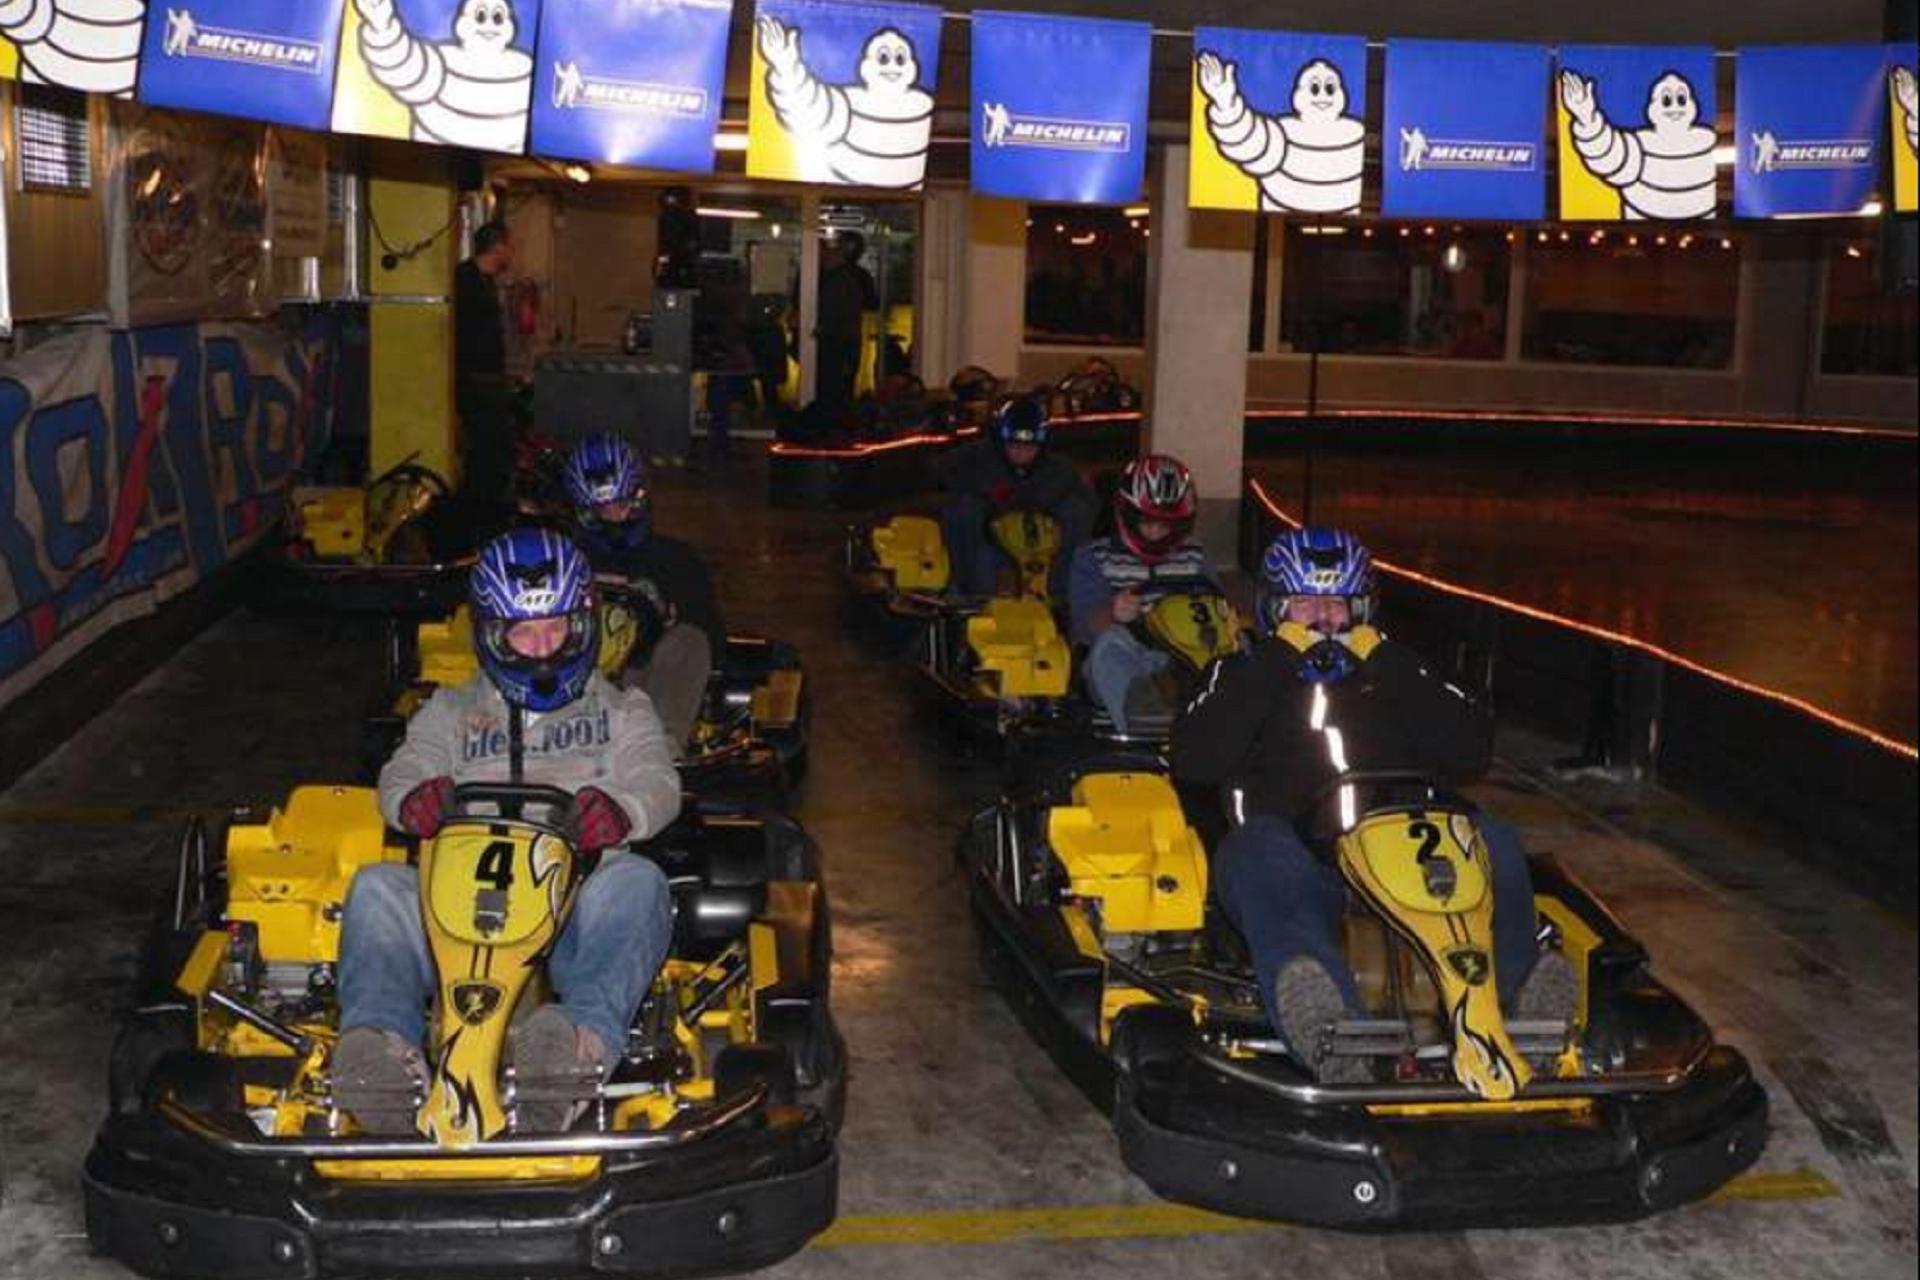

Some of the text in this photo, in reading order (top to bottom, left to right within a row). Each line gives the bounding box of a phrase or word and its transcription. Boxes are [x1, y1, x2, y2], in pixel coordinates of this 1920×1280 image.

[197, 34, 315, 63] MICHELIN
[1012, 123, 1124, 143] MICHELIN
[1429, 146, 1530, 163] MICHELIN
[1781, 146, 1869, 162] MICHELIN
[1409, 822, 1447, 863] 2
[475, 841, 514, 890] 4
